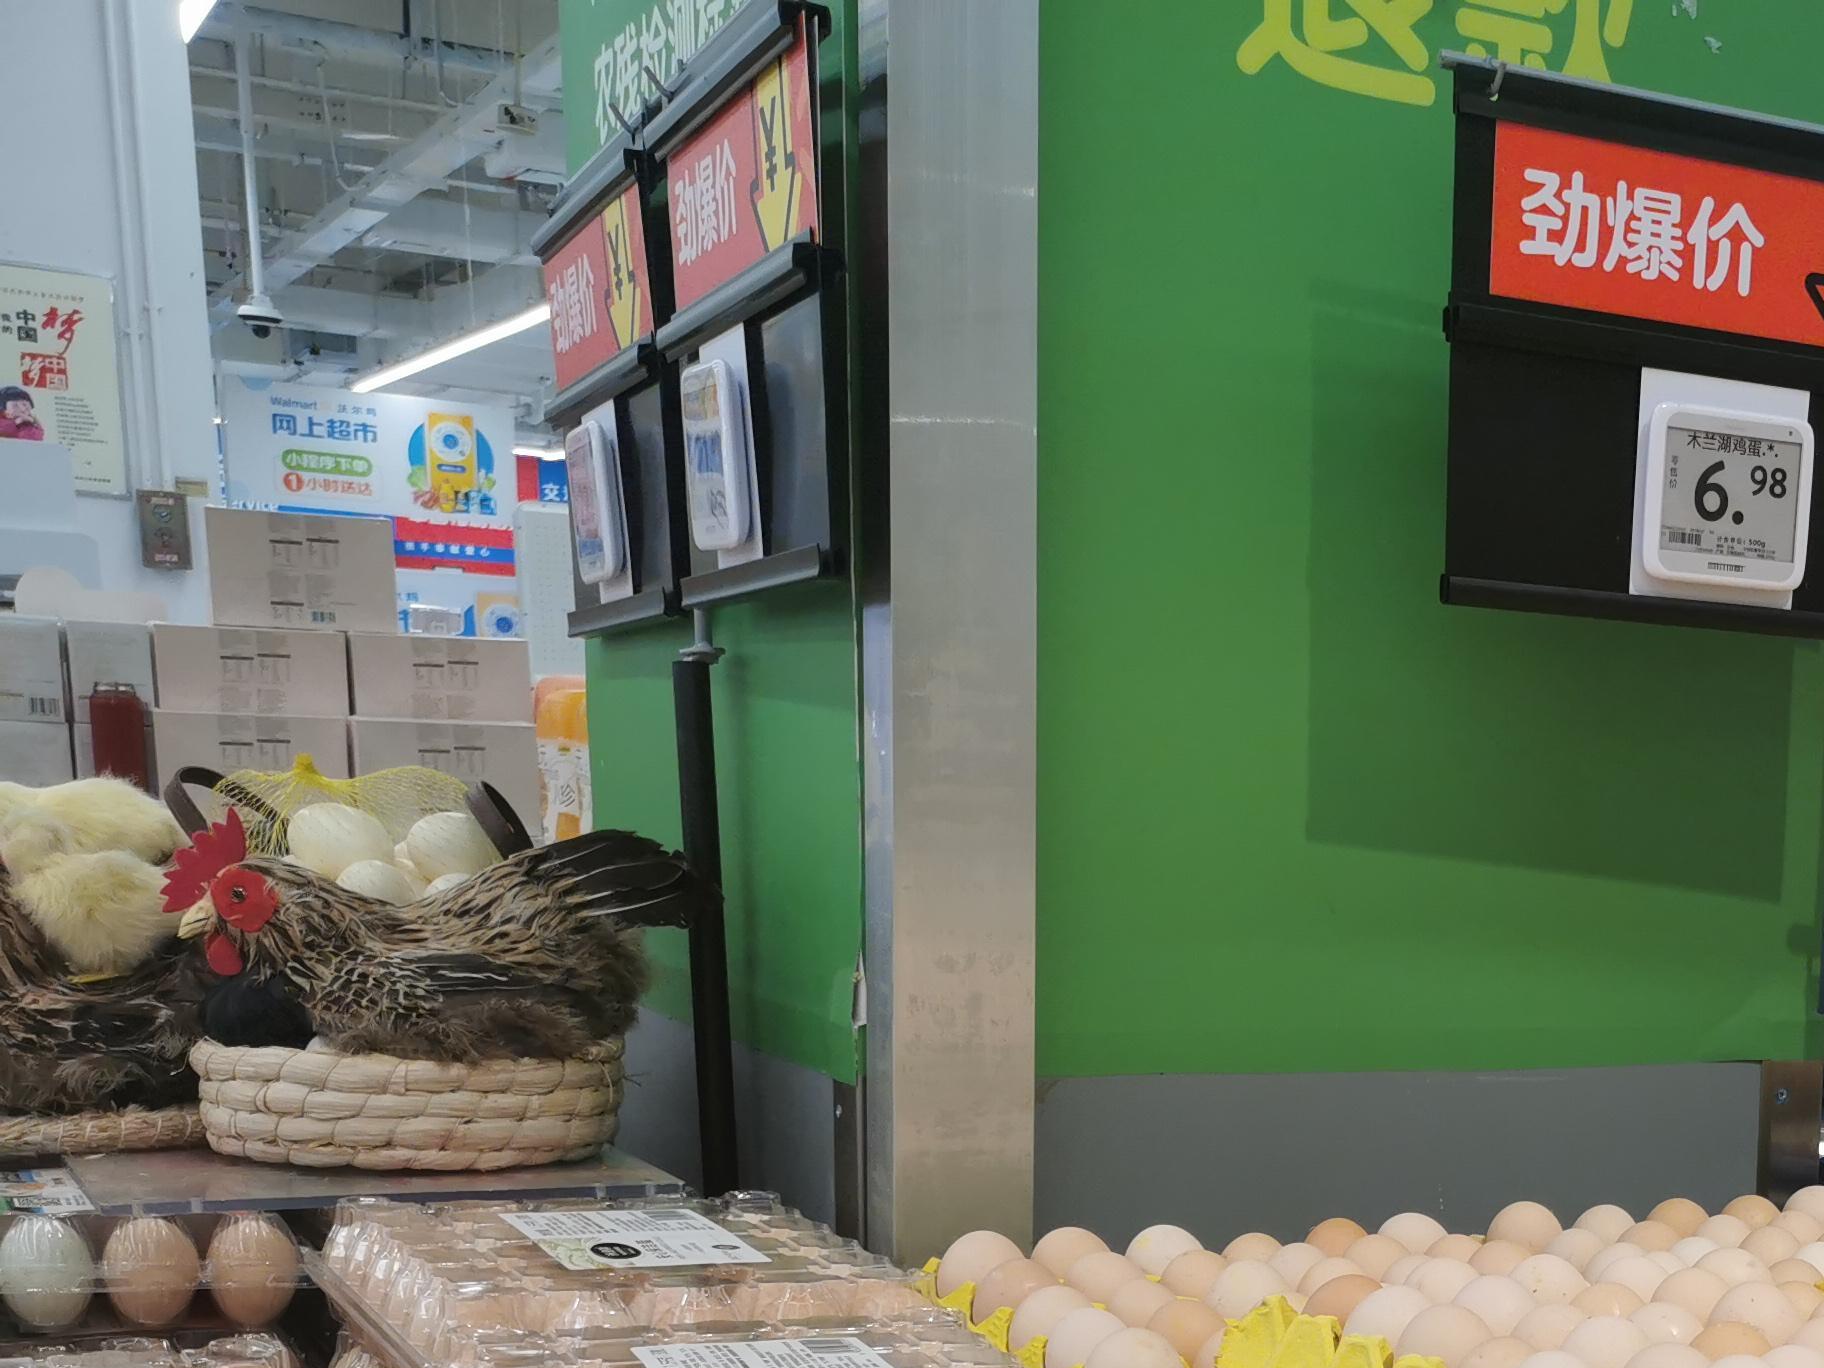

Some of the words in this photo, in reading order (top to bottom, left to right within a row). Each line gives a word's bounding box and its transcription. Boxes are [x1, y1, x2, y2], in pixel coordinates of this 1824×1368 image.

[675, 138, 737, 265] 劲爆价
[1519, 168, 1765, 296] 劲爆价
[550, 253, 597, 353] 劲爆价
[270, 396, 318, 411] Walmart
[337, 404, 377, 417] 沃尔玛
[271, 412, 378, 443] 网上超市
[285, 452, 368, 474] 小程序下单
